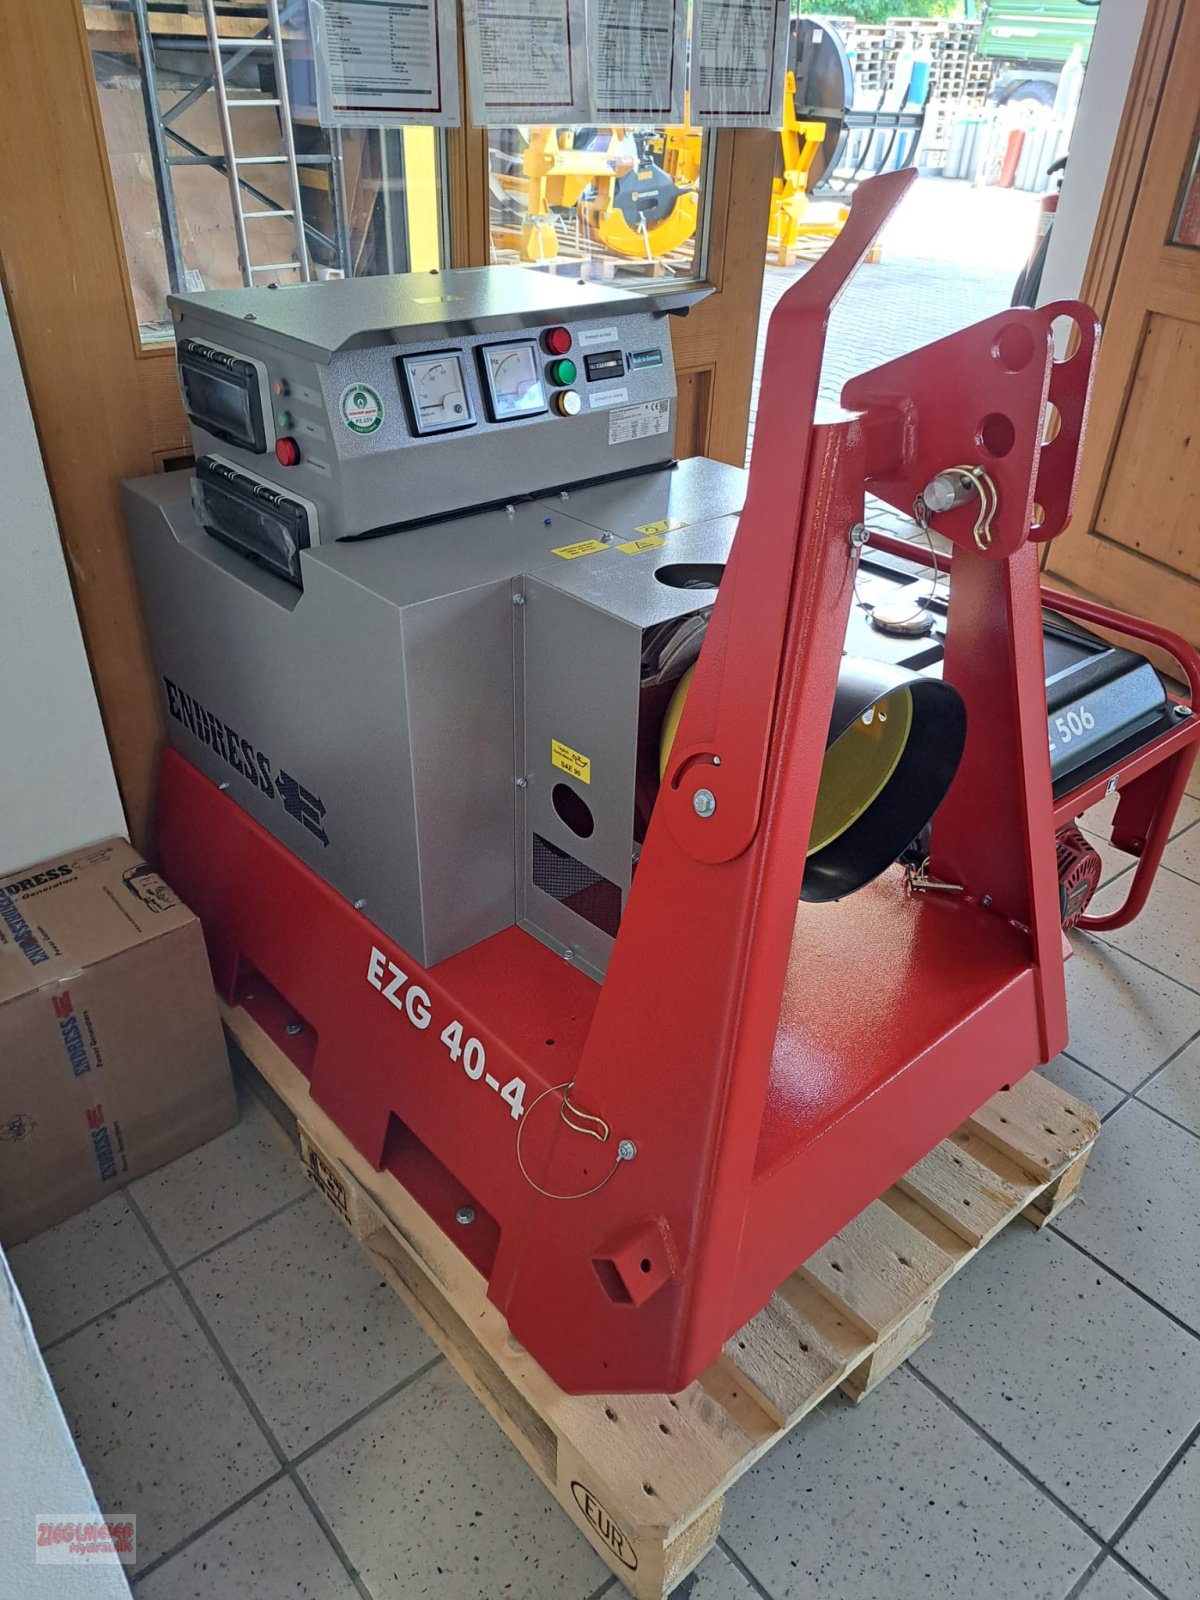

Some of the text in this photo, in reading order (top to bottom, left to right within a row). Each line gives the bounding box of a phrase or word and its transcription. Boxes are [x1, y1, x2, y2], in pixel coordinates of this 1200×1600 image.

[163, 675, 275, 799] ENDRESS
[1055, 705, 1096, 743] 506
[560, 760, 573, 773] SAE
[59, 1015, 91, 1079] ENDRESS
[367, 945, 527, 1121] EZG 40-4
[585, 1493, 624, 1557] EUR
